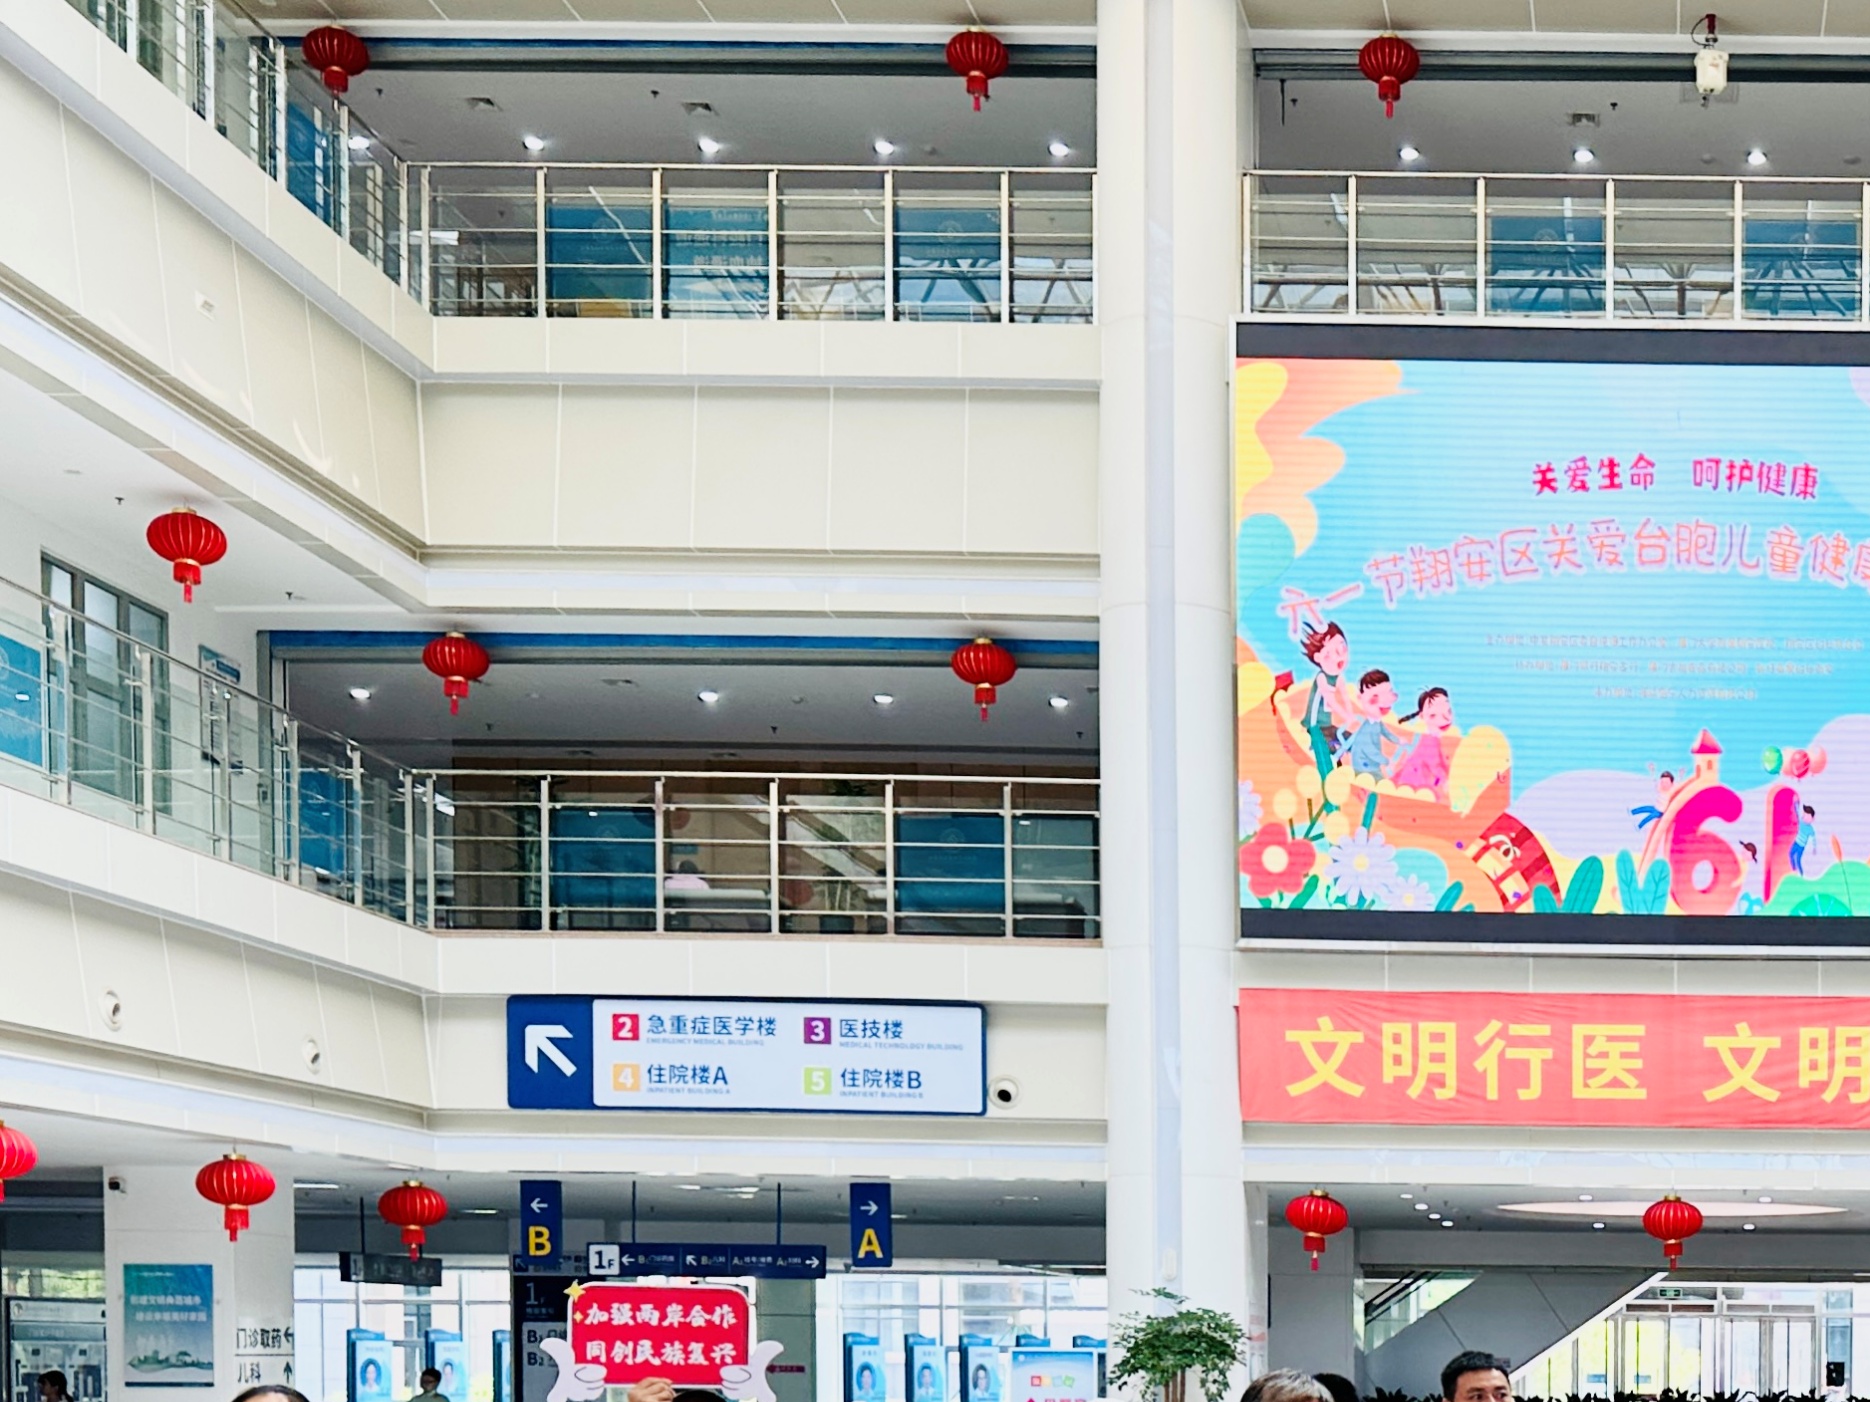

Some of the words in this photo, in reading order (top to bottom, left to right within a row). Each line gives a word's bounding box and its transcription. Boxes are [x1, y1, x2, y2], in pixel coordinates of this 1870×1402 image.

[1532, 453, 1657, 496] 关爱生命
[1692, 457, 1819, 500] 呵护健康
[616, 1015, 634, 1039] 2
[646, 1015, 777, 1037] 急重症医学楼
[809, 1020, 826, 1042] 3
[839, 1018, 904, 1040] 医技楼
[646, 1037, 692, 1045] EMERGENCY
[693, 1038, 727, 1046] MEDICAL
[728, 1039, 765, 1047] BUILDING
[839, 1041, 872, 1049] MEDICAL
[874, 1041, 926, 1050] TECHNOLOGY
[926, 1043, 964, 1051] BUILDING
[1284, 1016, 1648, 1101] 文明行医
[617, 1066, 634, 1088] 4
[646, 1064, 729, 1087] 住院楼A
[811, 1069, 826, 1092] 5
[840, 1068, 922, 1090] 住院楼B
[527, 1225, 551, 1256] B
[857, 1228, 884, 1259] A
[594, 1250, 616, 1272] 1F
[584, 1302, 739, 1328] 加强两岸合作
[236, 1327, 282, 1350] 门诊取药
[585, 1340, 737, 1367] 同创民族复兴
[237, 1361, 261, 1384] 儿科
